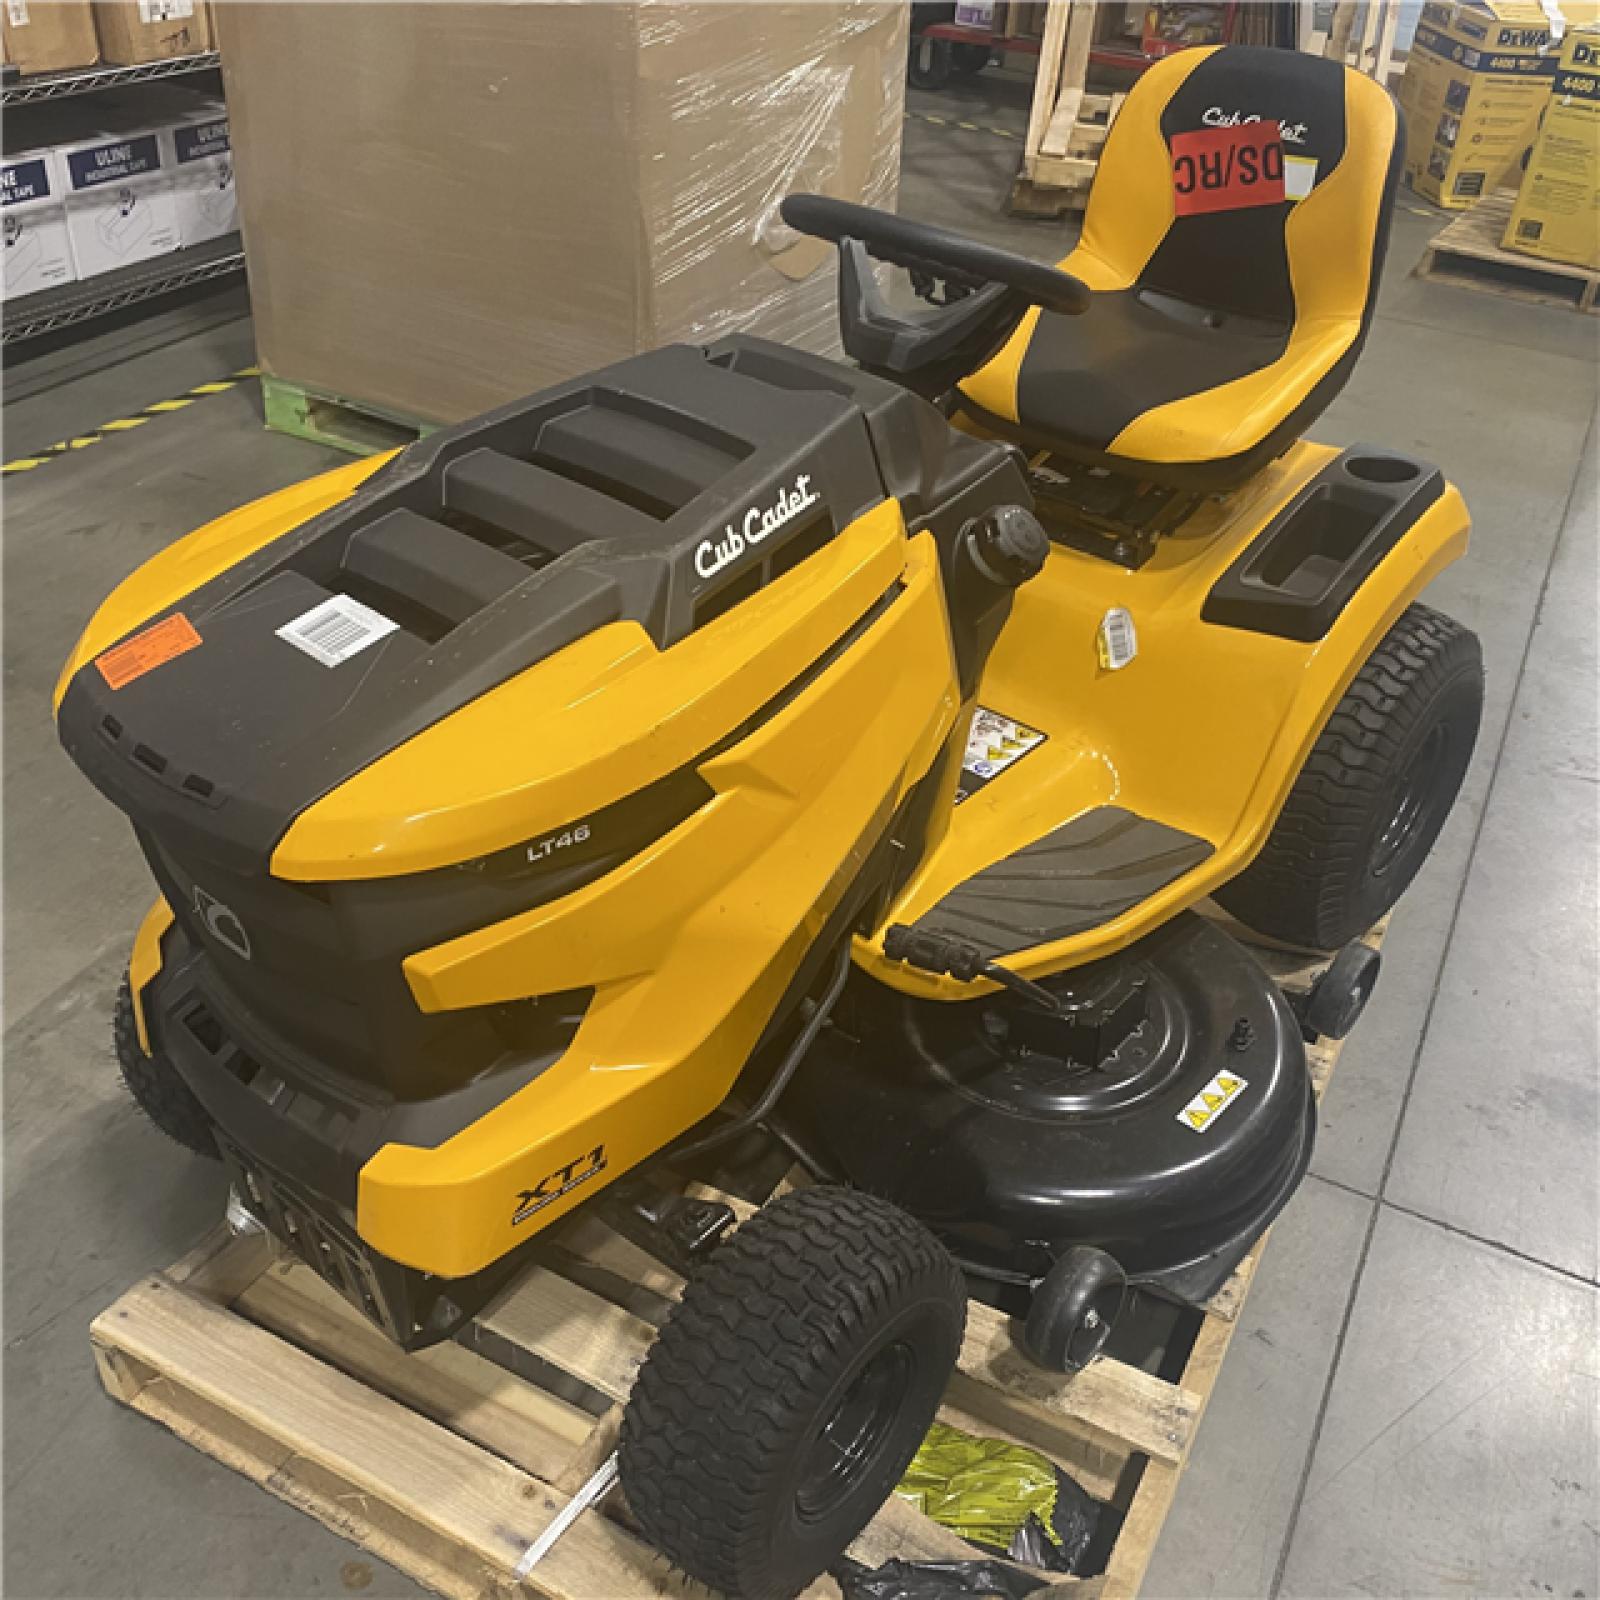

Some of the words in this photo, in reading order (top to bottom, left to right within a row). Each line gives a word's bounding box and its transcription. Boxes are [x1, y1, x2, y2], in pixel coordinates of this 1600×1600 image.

[1174, 142, 1284, 193] DS/RC
[694, 524, 745, 578] Cub
[743, 474, 817, 543] Cadet
[526, 824, 591, 863] LT46
[513, 1144, 608, 1214] XT1
